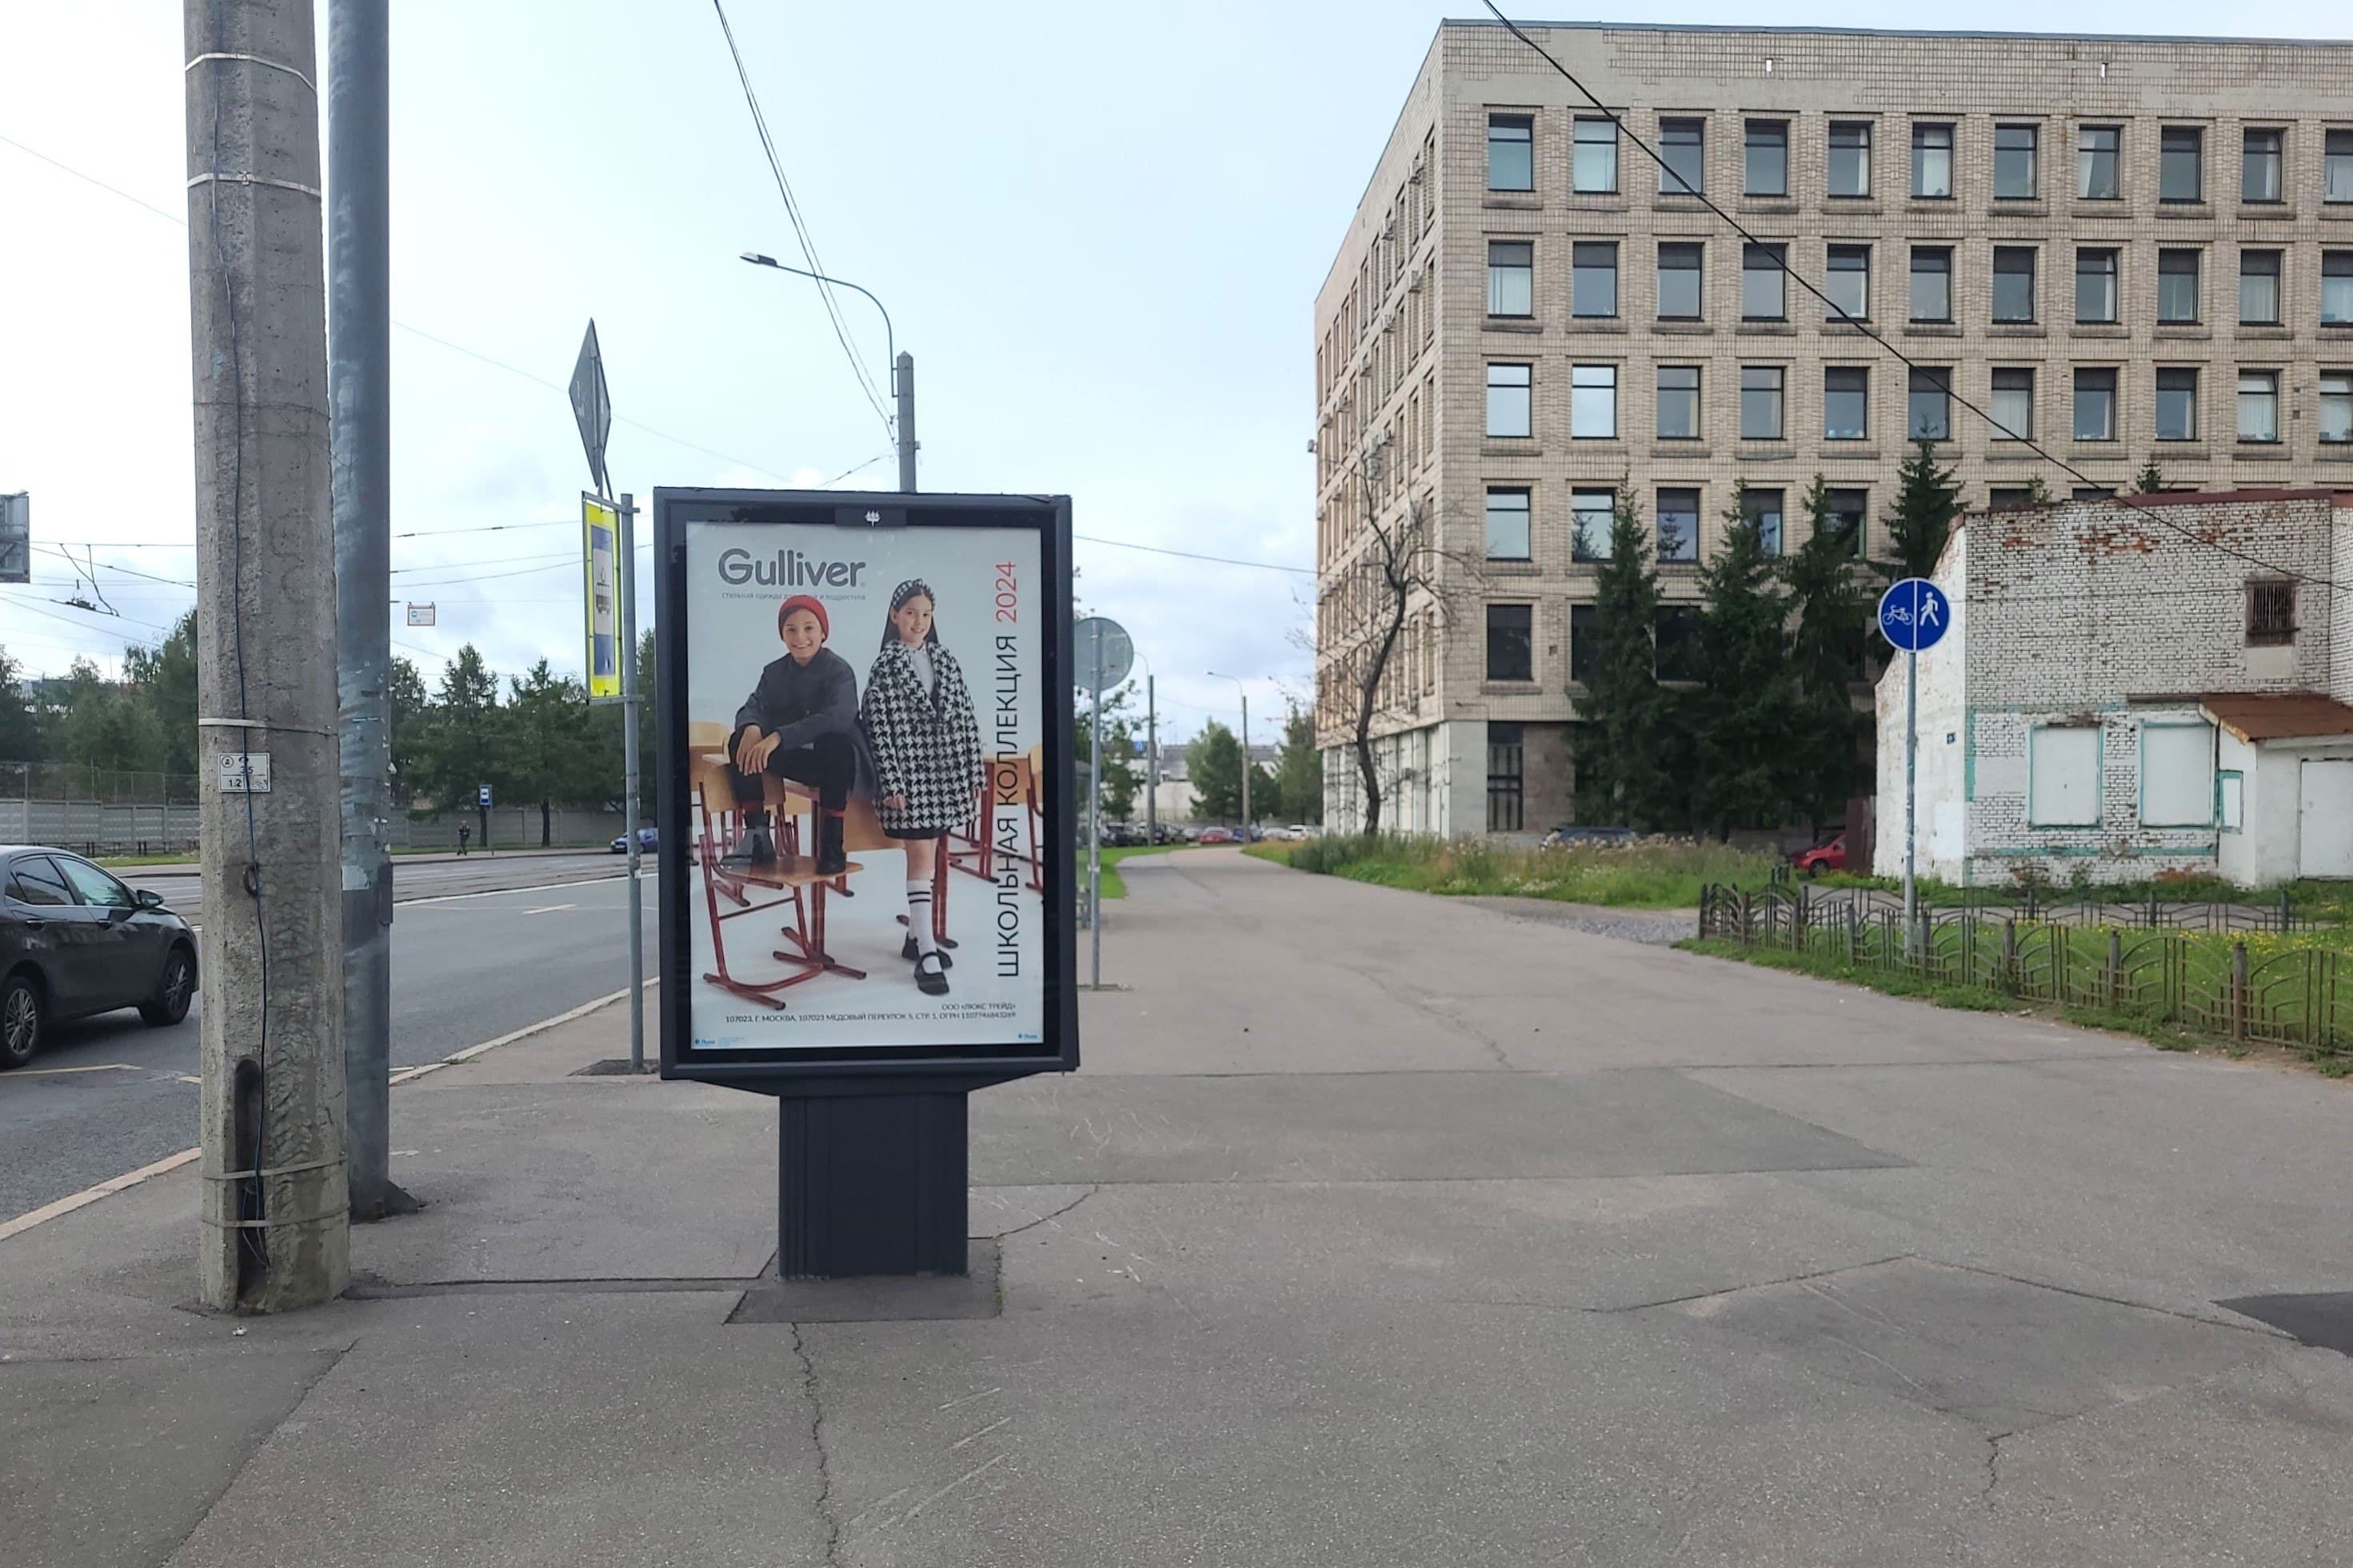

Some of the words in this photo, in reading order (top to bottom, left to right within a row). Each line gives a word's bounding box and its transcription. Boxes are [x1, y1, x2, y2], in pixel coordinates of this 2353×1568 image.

[718, 549, 866, 587] Gulliver
[995, 561, 1017, 623] 2024
[996, 636, 1022, 805] КОЛЛЕКЦИЯ
[997, 816, 1019, 978] ШКОЛЬНАЯ
